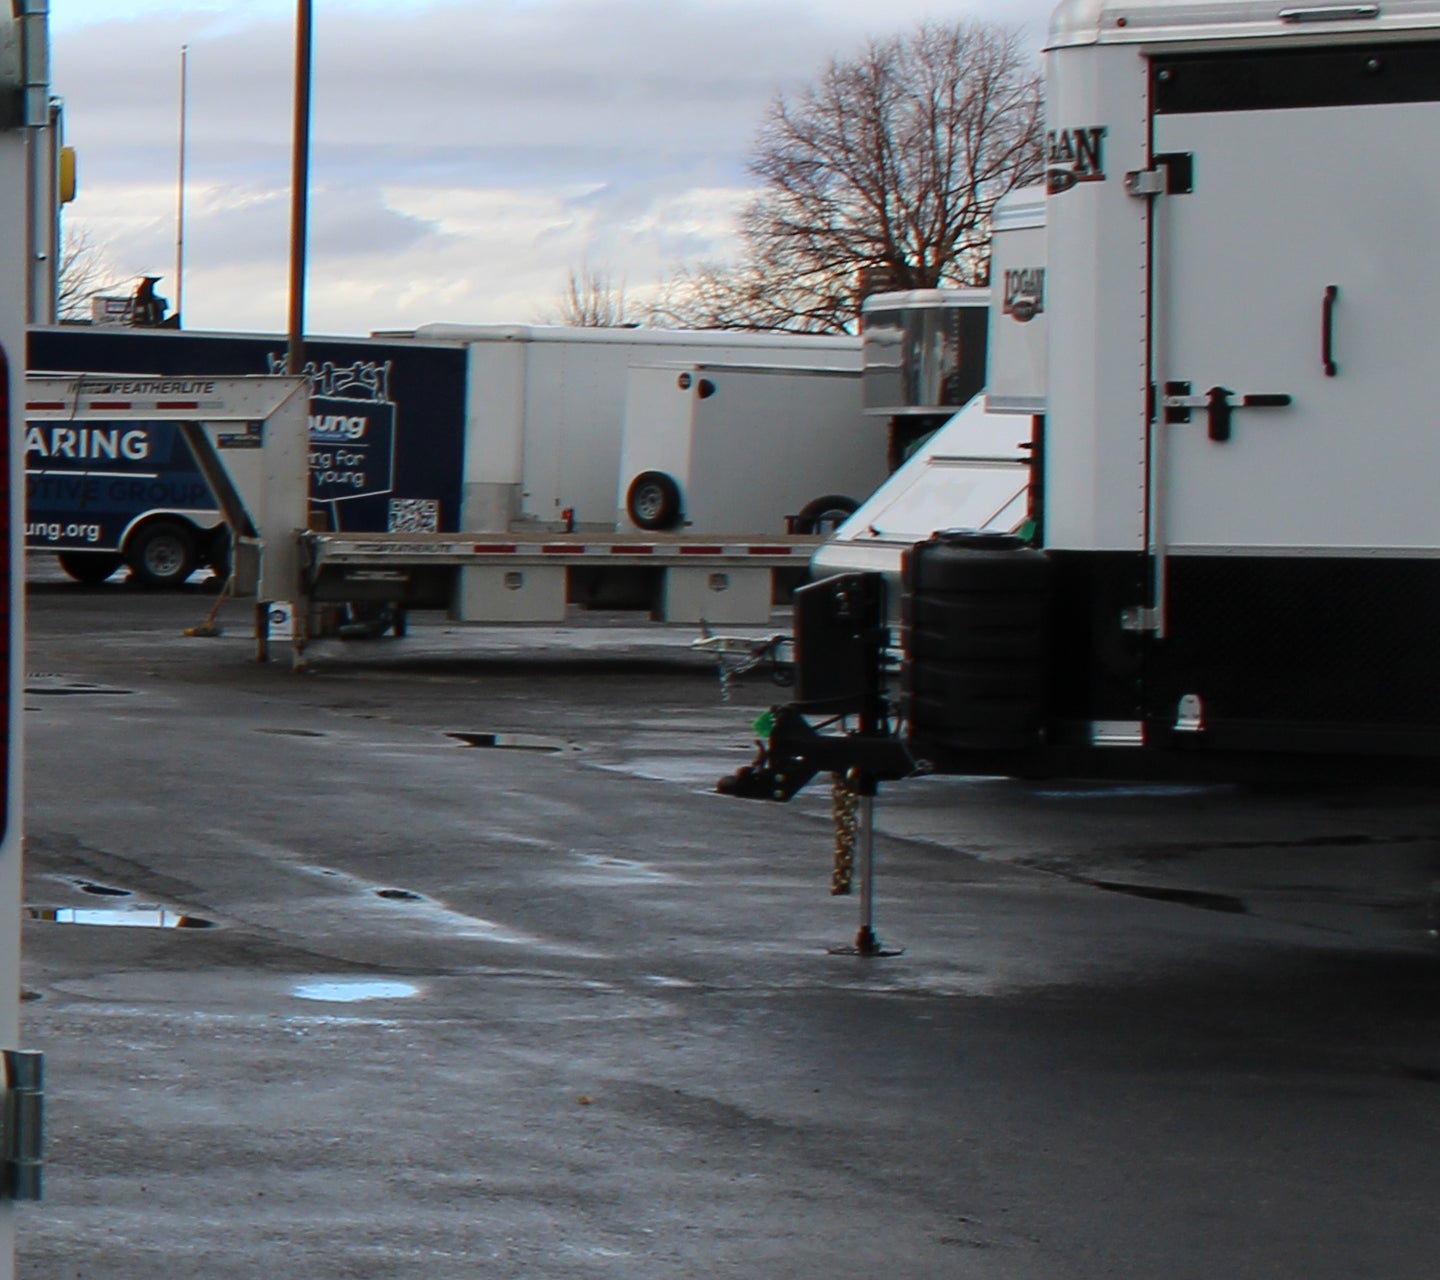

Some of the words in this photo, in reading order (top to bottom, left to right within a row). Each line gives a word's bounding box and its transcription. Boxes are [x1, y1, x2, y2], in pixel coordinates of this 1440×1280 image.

[112, 382, 215, 394] FEATHERLITE
[25, 426, 150, 460] ARING
[336, 449, 366, 465] for
[315, 470, 365, 488] young
[108, 481, 206, 504] GROUP
